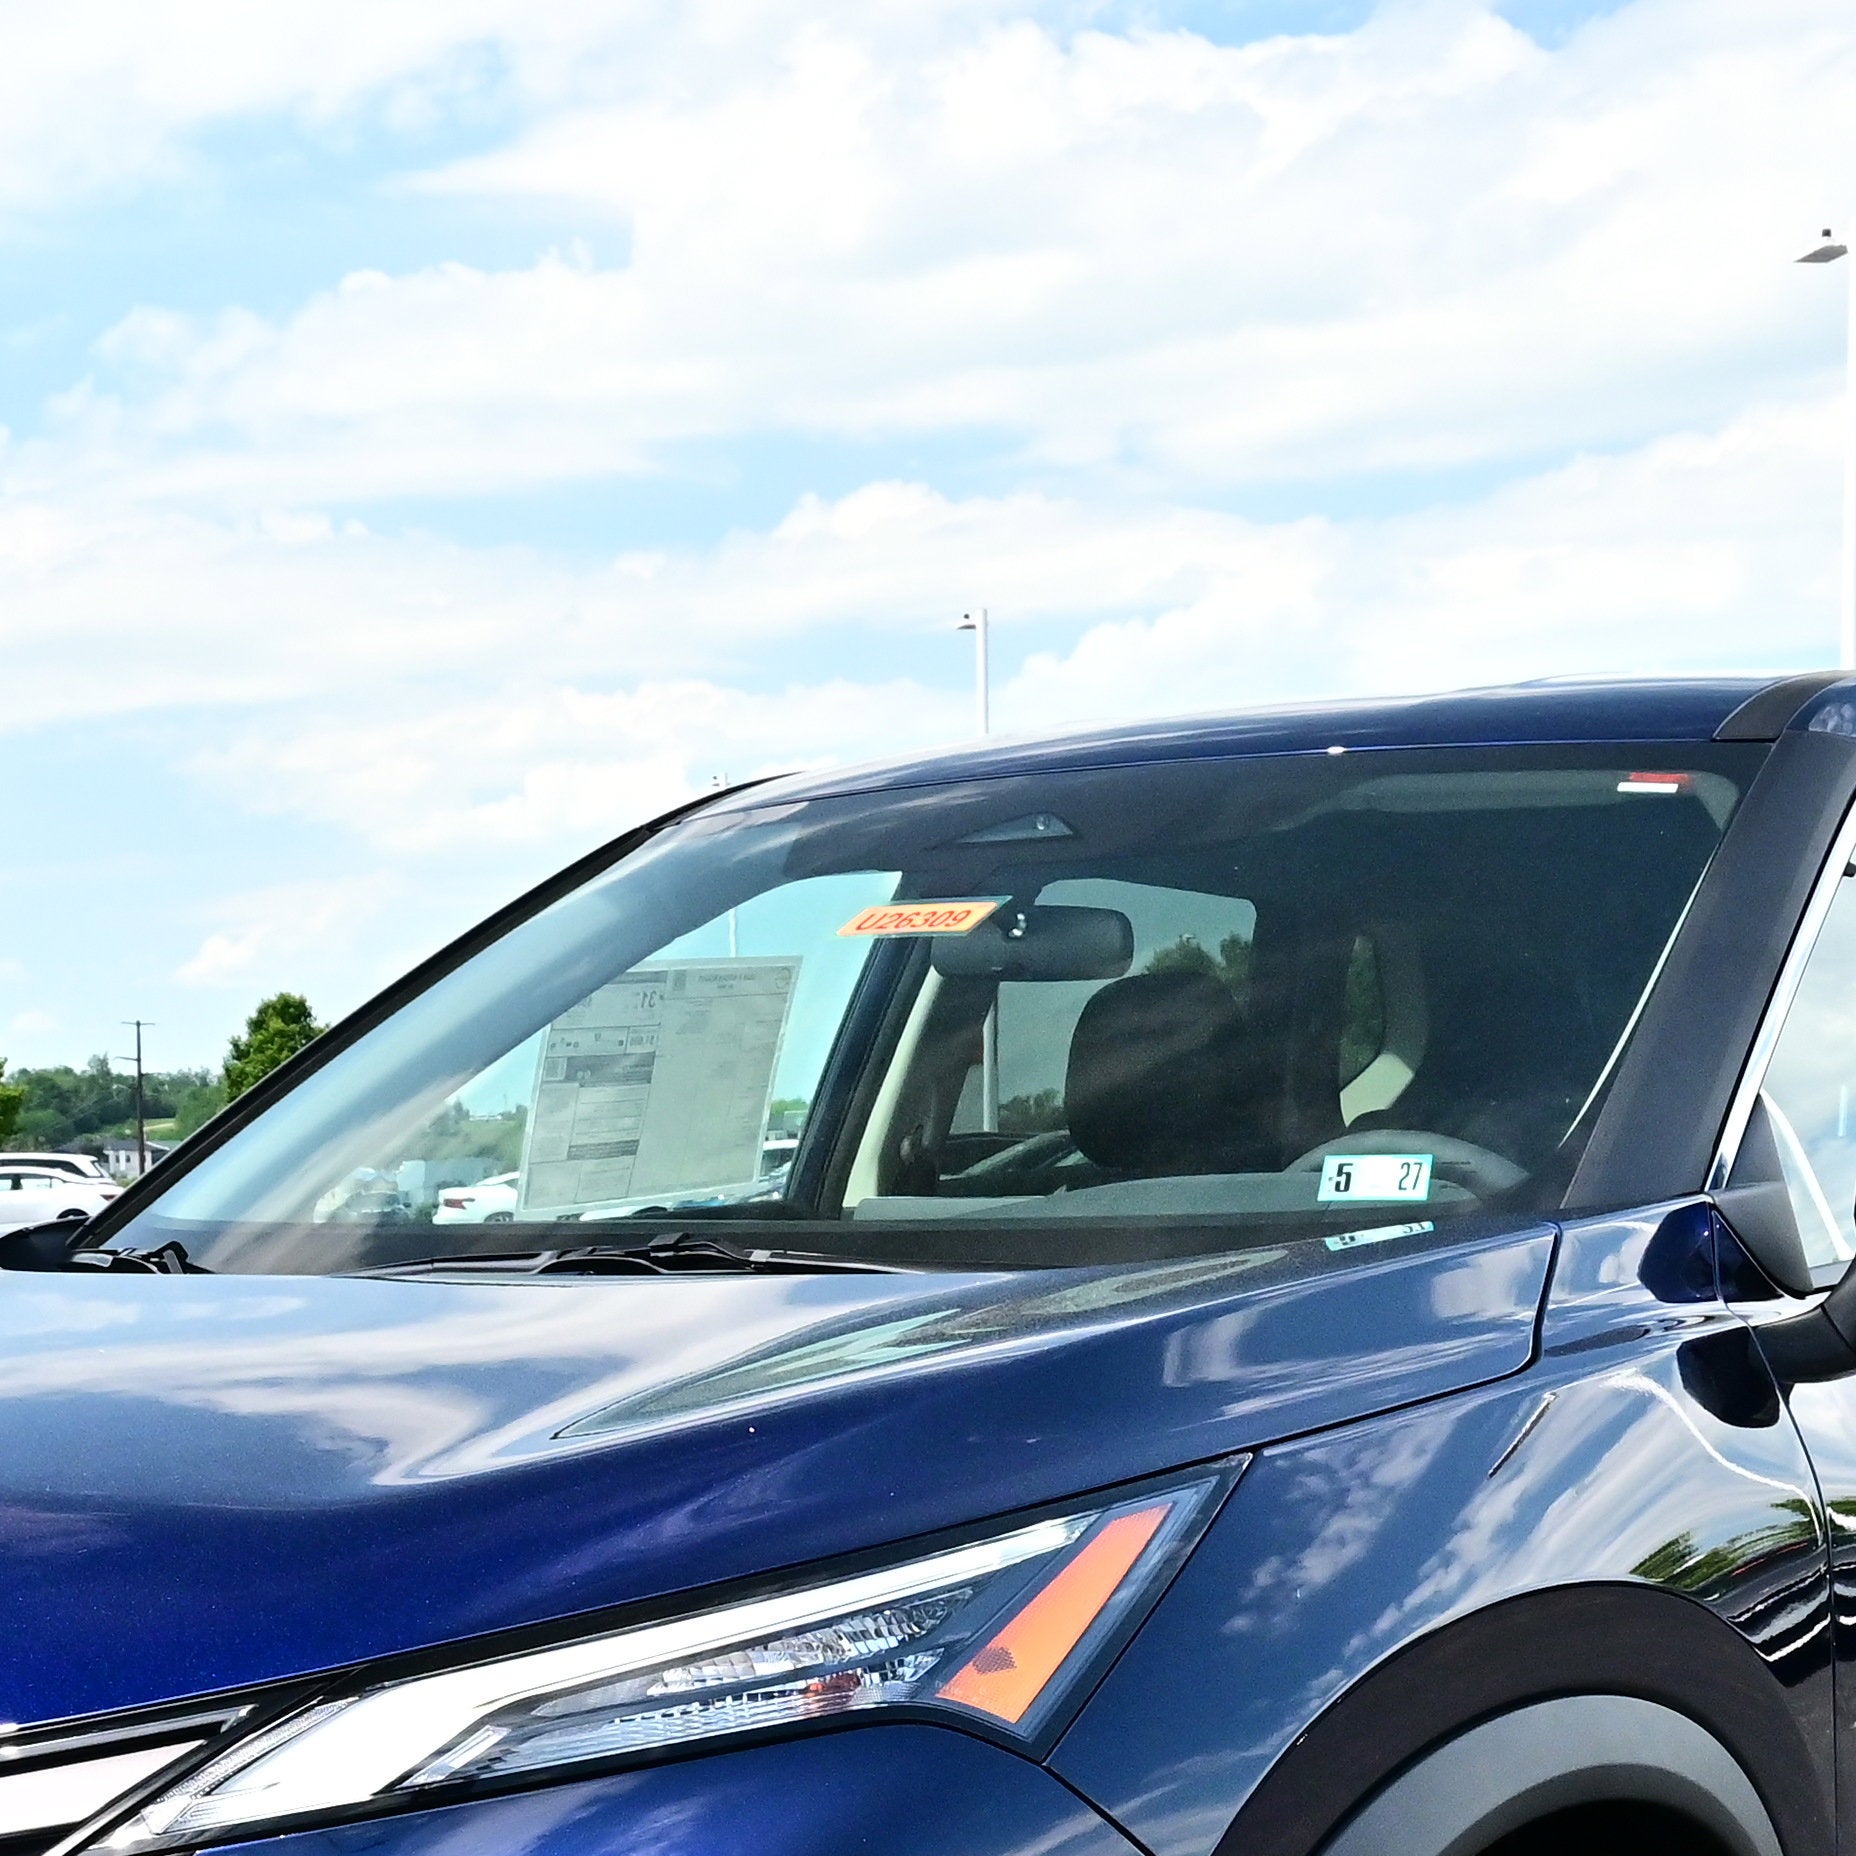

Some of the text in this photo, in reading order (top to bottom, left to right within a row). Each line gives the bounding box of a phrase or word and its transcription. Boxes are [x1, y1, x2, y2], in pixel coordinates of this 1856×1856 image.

[855, 909, 972, 931] U26309
[1334, 1161, 1424, 1193] 5 27
